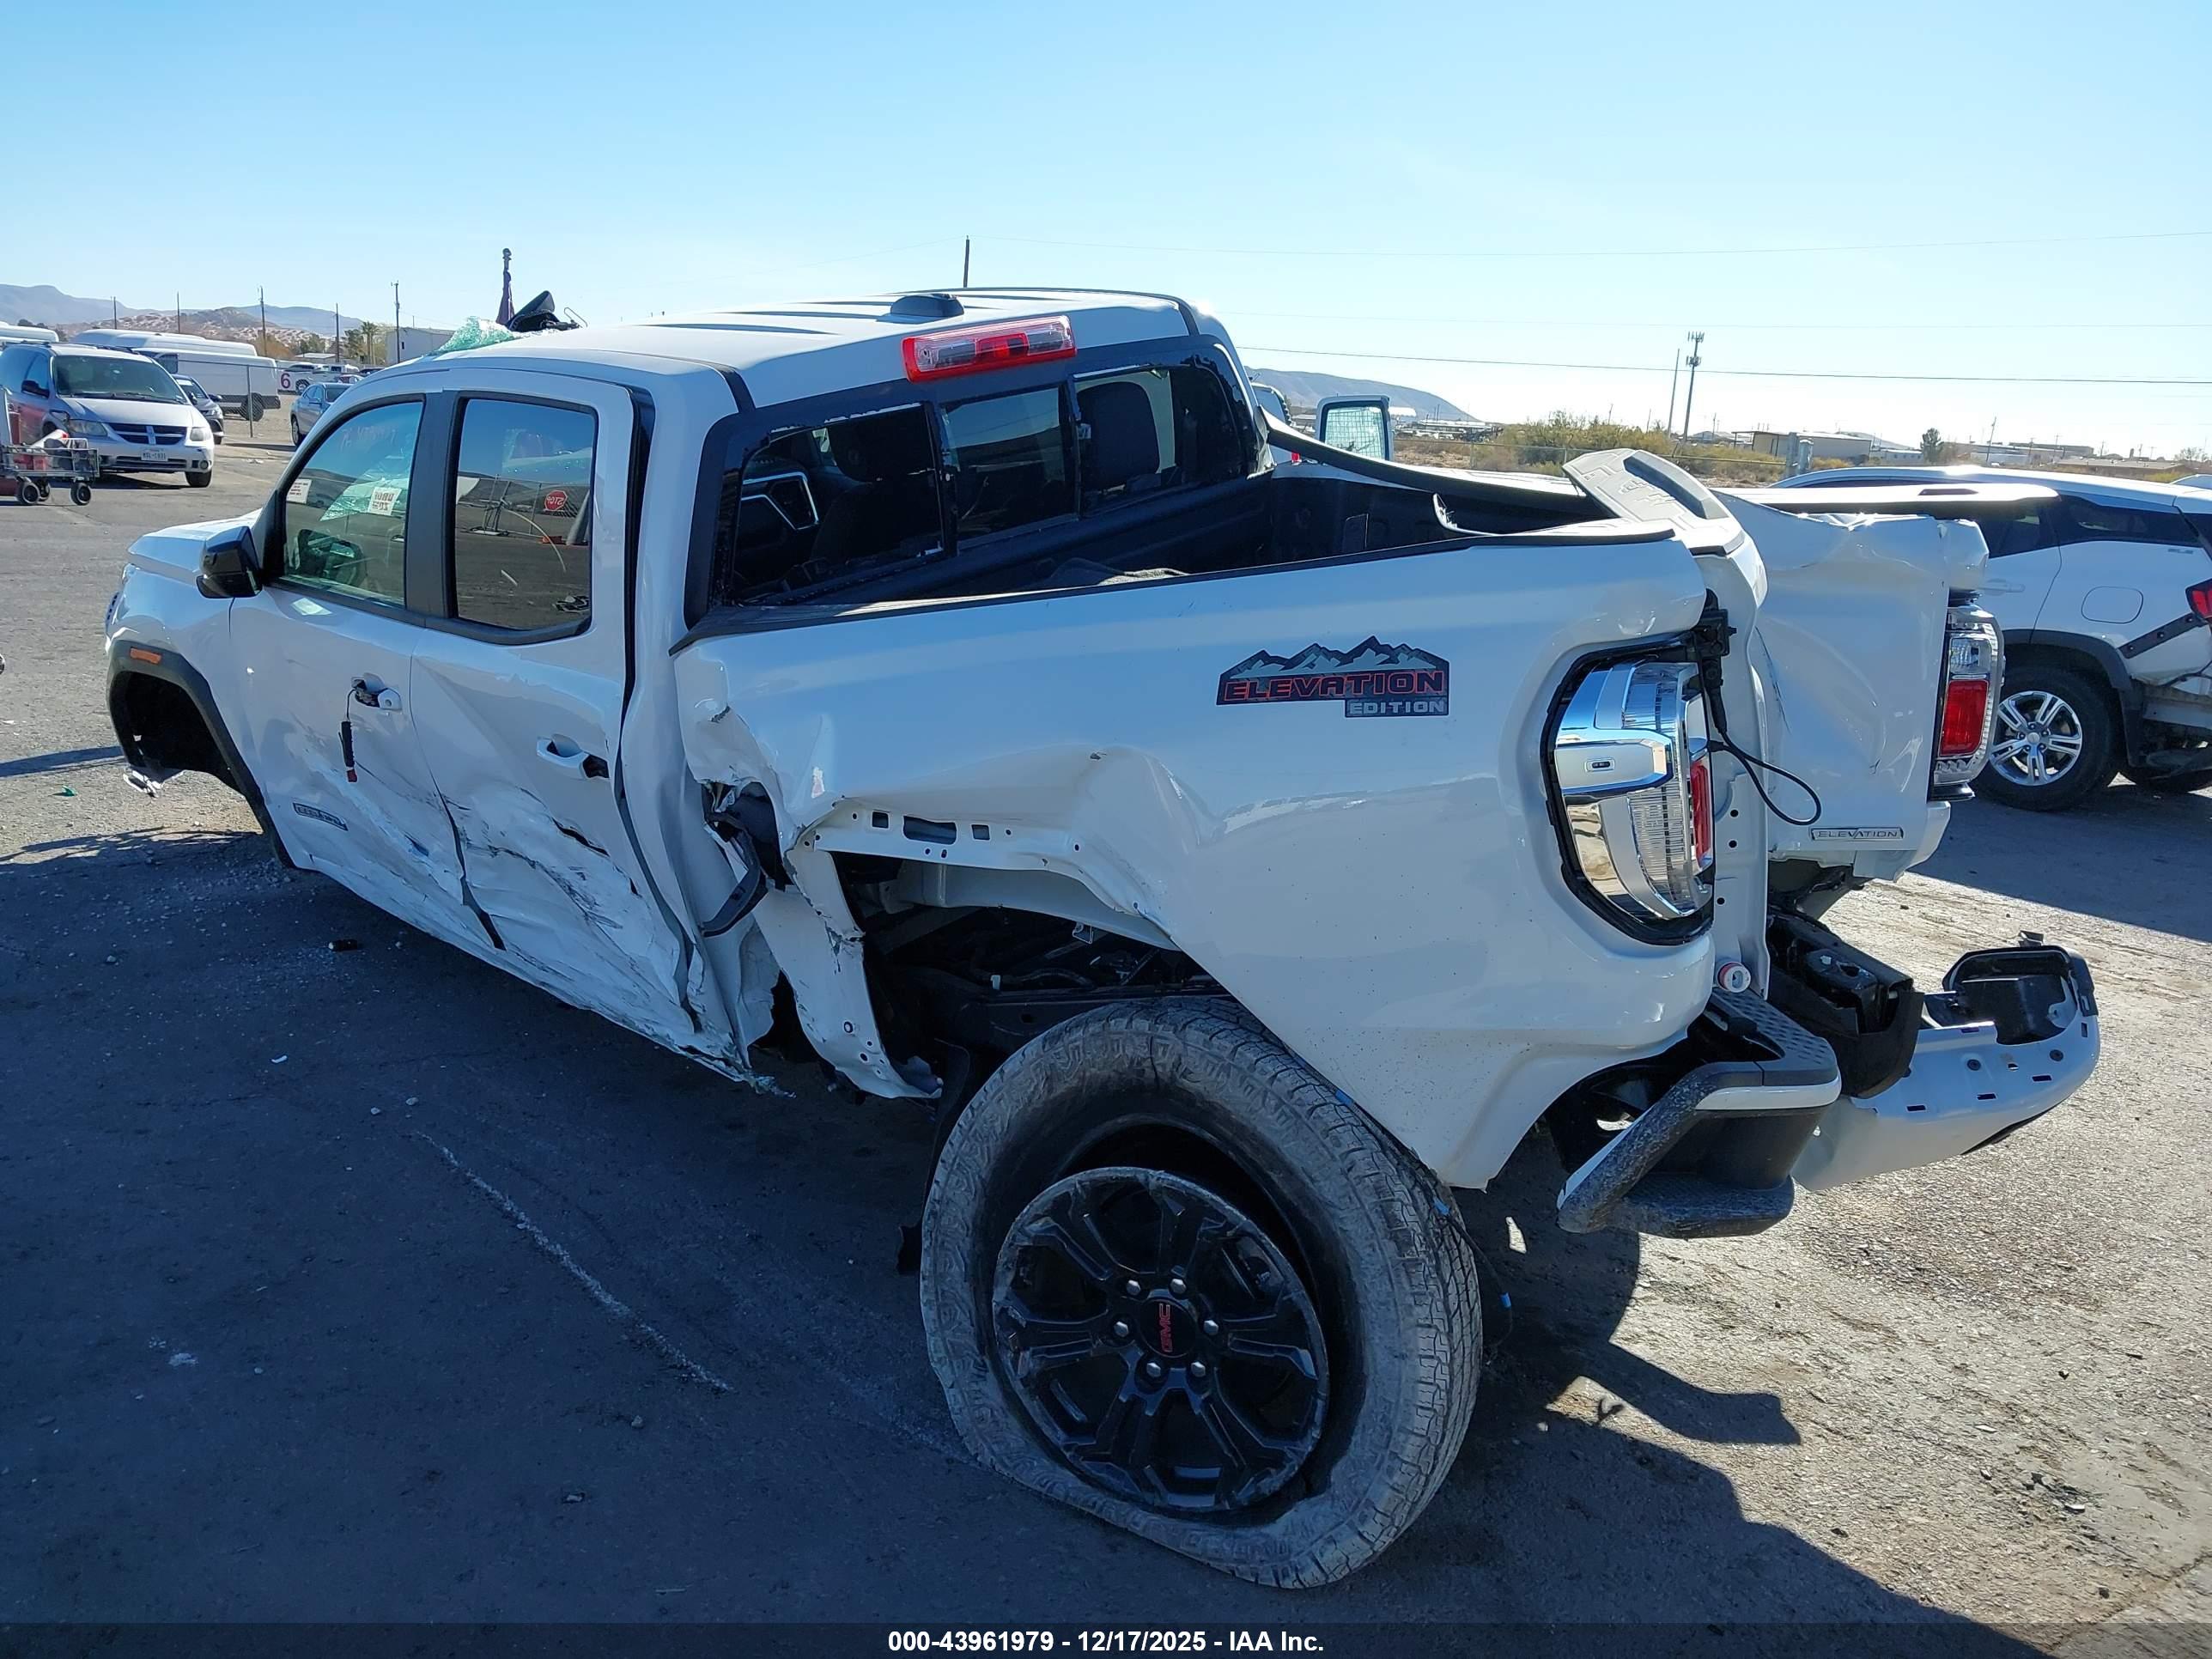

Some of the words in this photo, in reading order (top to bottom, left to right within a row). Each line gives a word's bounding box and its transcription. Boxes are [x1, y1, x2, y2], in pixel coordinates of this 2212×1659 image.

[281, 373, 290, 388] 6
[1224, 670, 1445, 701] ELEVATION
[1349, 700, 1444, 714] EDITION
[1158, 1303, 1173, 1352] GMC
